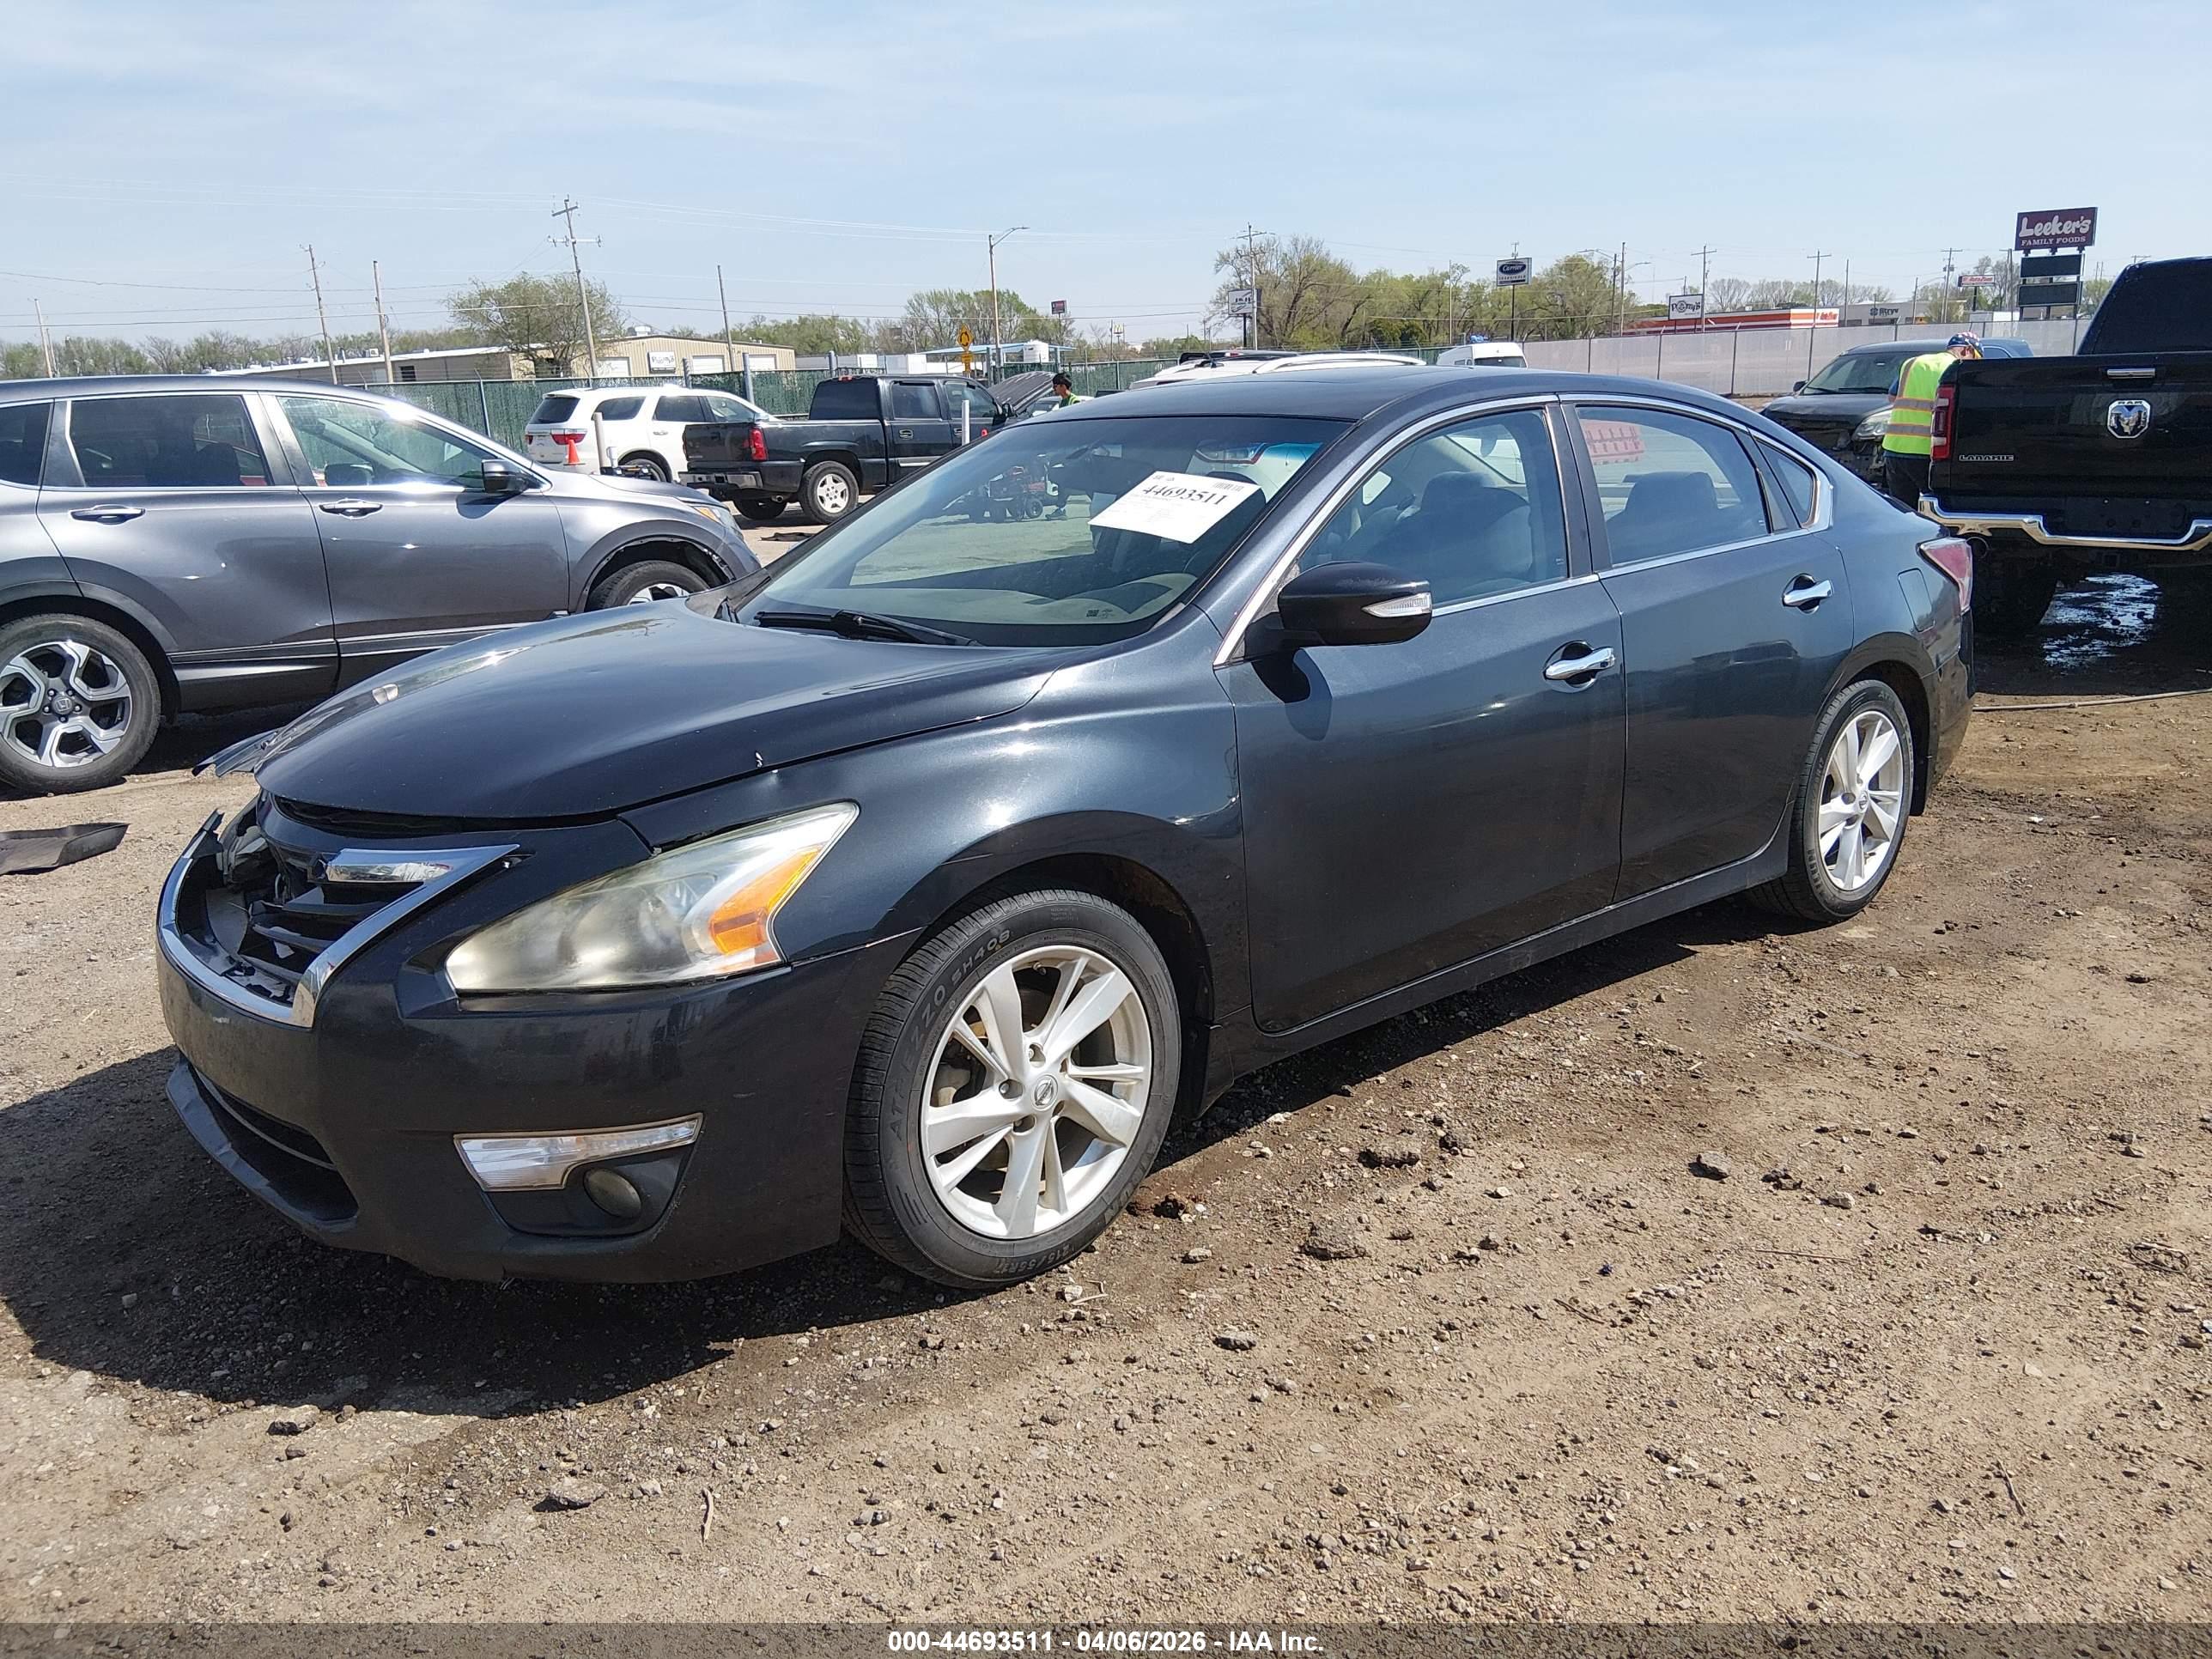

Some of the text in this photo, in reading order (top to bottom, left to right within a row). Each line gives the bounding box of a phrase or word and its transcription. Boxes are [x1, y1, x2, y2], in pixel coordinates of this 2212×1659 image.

[2019, 215, 2091, 237] Leeker's
[2021, 238, 2055, 246] FAMILY
[1959, 453, 2014, 462] LARAMIE
[1143, 483, 1228, 505] 44693511
[951, 928, 1012, 988] SH408
